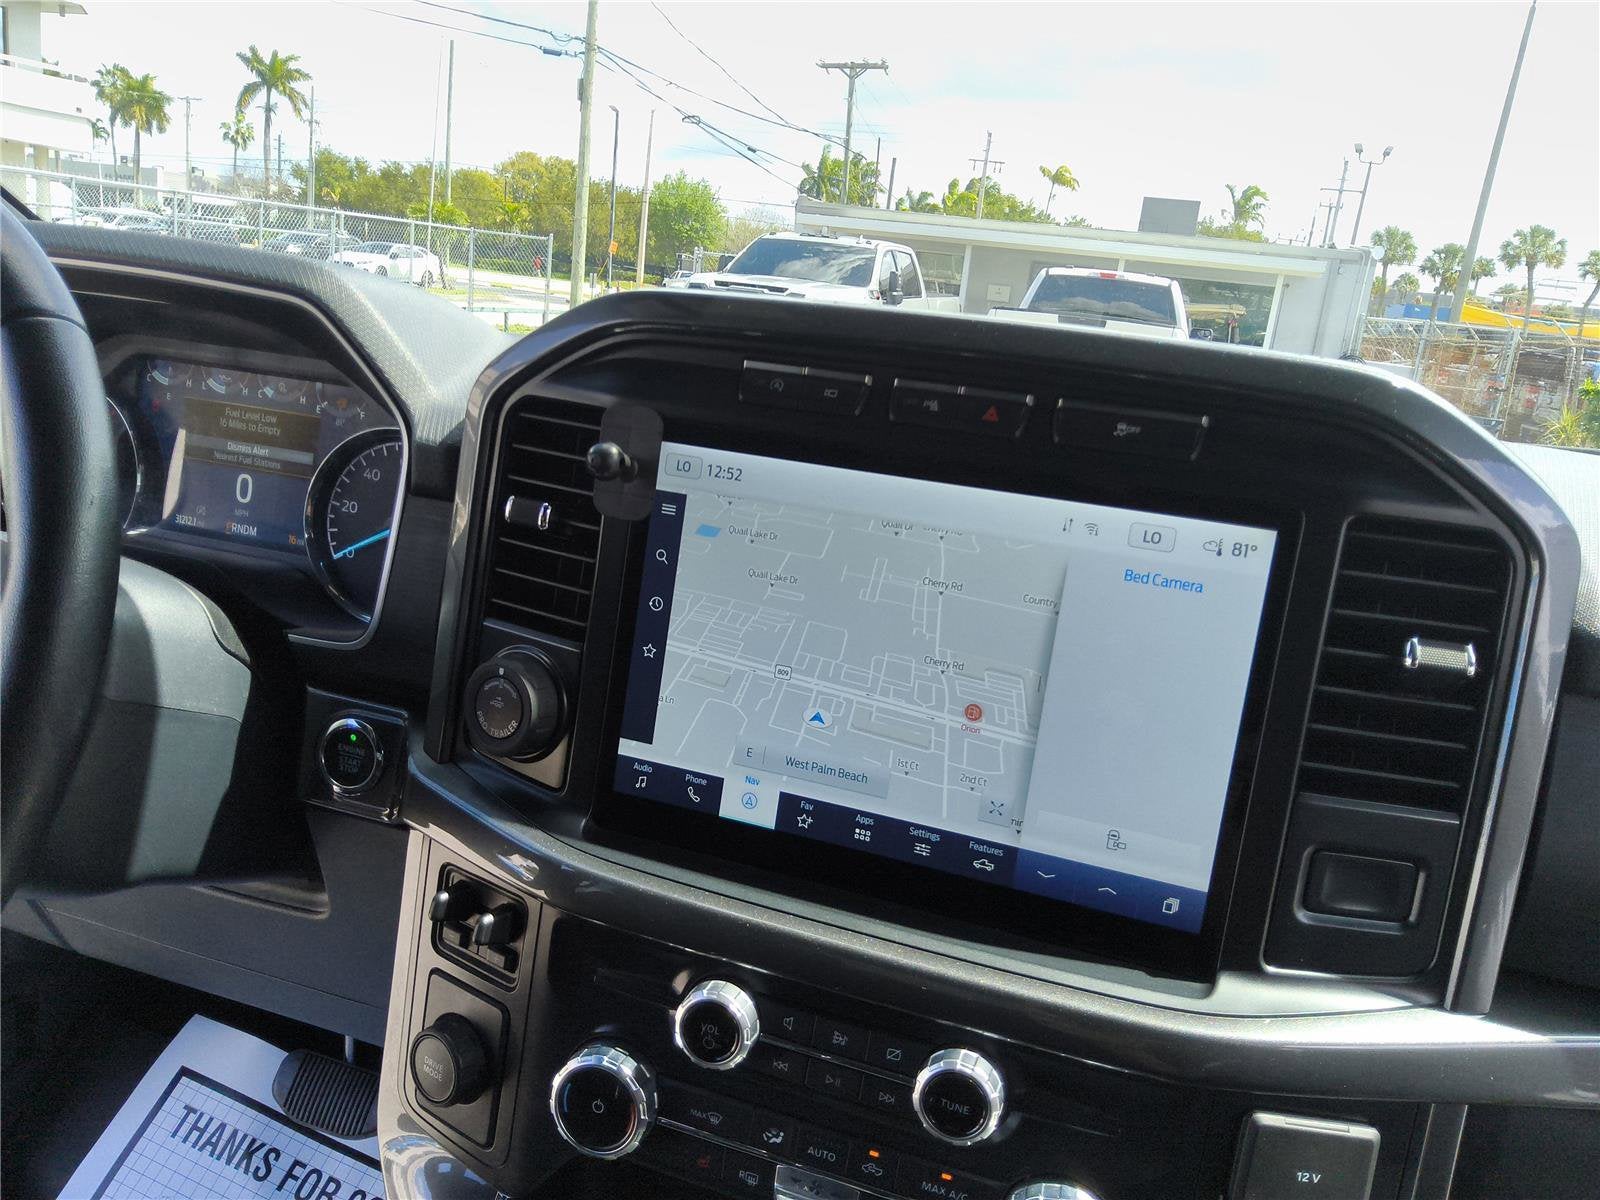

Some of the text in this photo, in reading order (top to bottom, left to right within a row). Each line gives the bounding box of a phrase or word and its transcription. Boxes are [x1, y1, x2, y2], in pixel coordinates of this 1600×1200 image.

[185, 379, 192, 388] H
[242, 387, 248, 396] H
[258, 389, 263, 398] C
[299, 396, 306, 405] H
[225, 407, 240, 417] Fuel
[261, 413, 278, 424] Low
[316, 405, 321, 414] E
[360, 411, 366, 420] F
[248, 423, 257, 432] to
[257, 424, 281, 436] Empty
[227, 441, 269, 457] Dismiss Alert
[254, 457, 281, 469] Stations
[676, 460, 692, 473] LO
[363, 468, 381, 481] 40
[706, 464, 743, 482] 12:52
[236, 473, 253, 504] 0
[341, 501, 358, 514] 20
[728, 525, 779, 542] Quail Lake Dr
[1142, 531, 1162, 546] LO
[748, 567, 799, 585] Quail Lake Dr
[1124, 569, 1204, 594] Bed Camera
[922, 577, 963, 593] Cherry Rd
[1022, 594, 1058, 609] Country
[923, 655, 964, 671] Cherry Rd
[777, 668, 790, 678] 809
[477, 710, 519, 738] PRO TRAILER
[746, 747, 753, 758] E
[633, 762, 653, 774] Audio
[785, 755, 868, 784] West Palm Beach
[897, 759, 919, 772] 1st Ct
[685, 774, 707, 787] Phone
[745, 776, 760, 787] Nav
[960, 773, 987, 788] 2nd Ct
[800, 800, 814, 812] Fav
[855, 814, 875, 827] Apps
[909, 827, 941, 843] Settings
[968, 840, 1004, 857] Features
[701, 1022, 720, 1036] VOL
[424, 1056, 443, 1073] DRIVE
[423, 1065, 442, 1081] MODE
[940, 1098, 971, 1115] TUNE
[690, 1108, 707, 1120] MAX
[170, 1105, 343, 1200] THANKS FOR
[807, 1146, 836, 1162] AUTO
[1296, 1171, 1321, 1184] 12 V
[921, 1181, 969, 1200] MAX A/C
